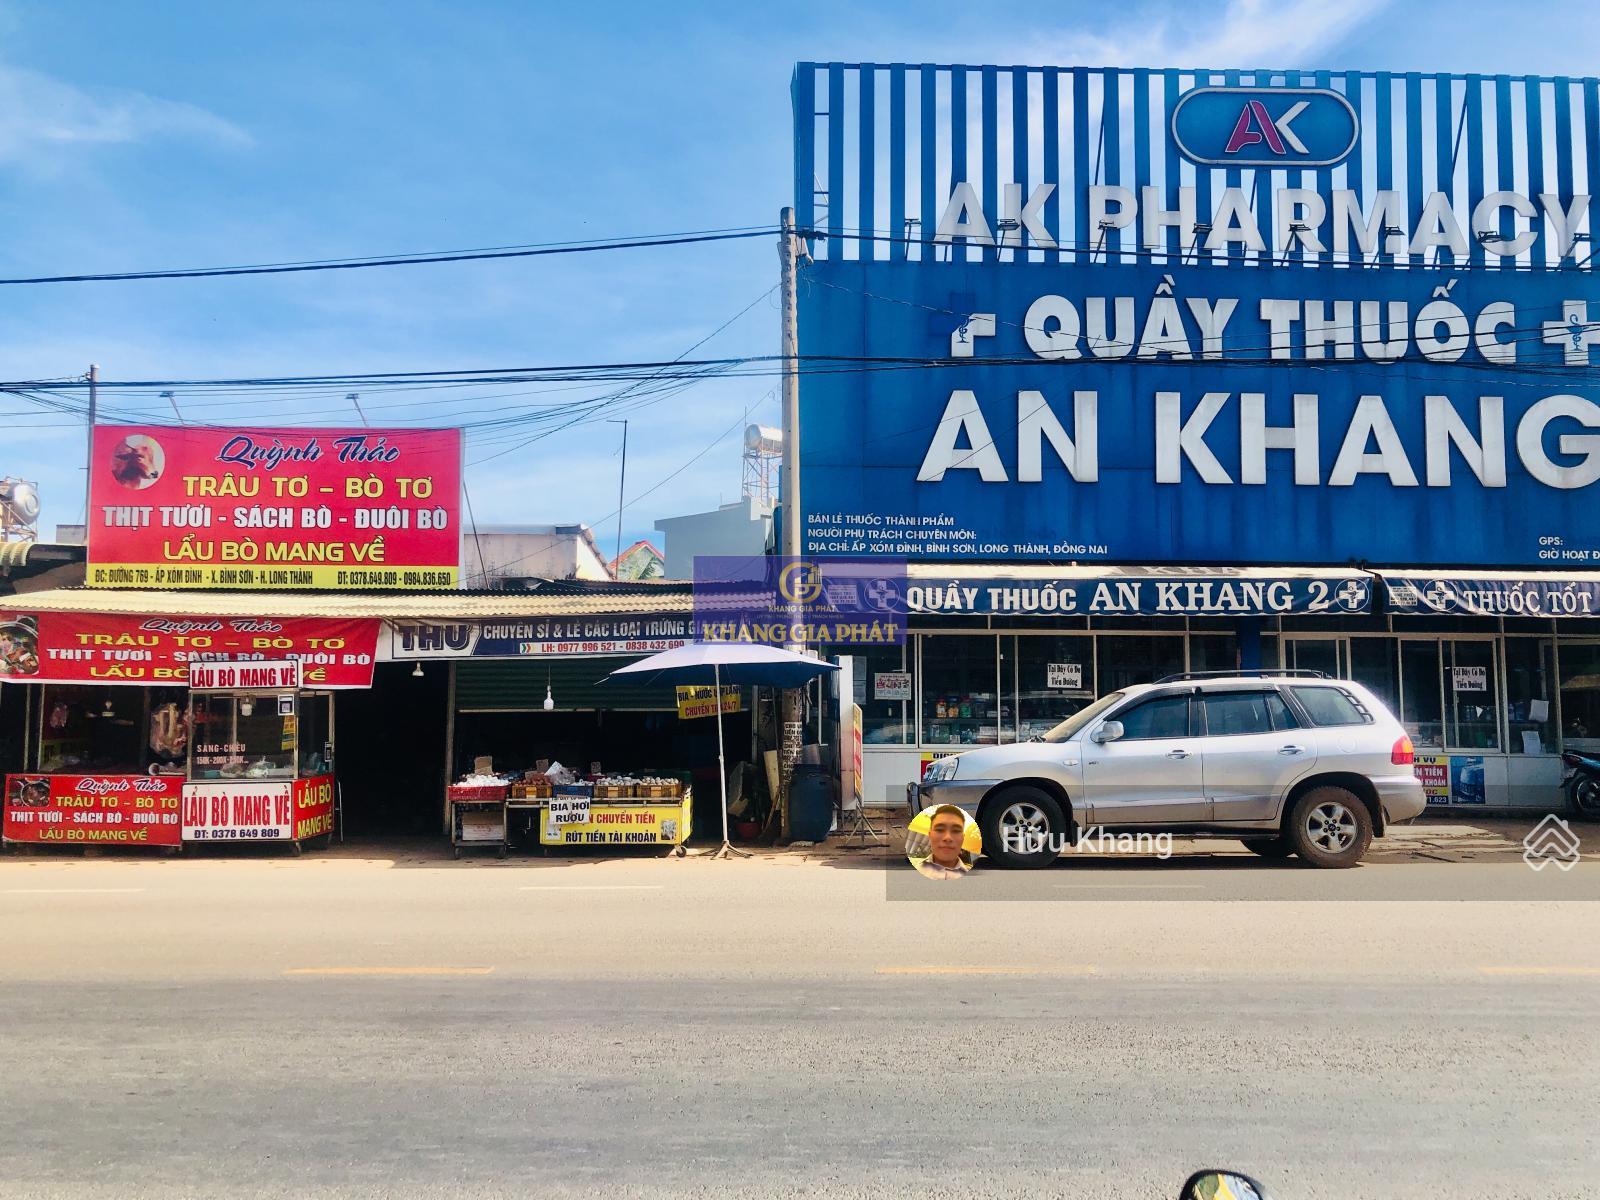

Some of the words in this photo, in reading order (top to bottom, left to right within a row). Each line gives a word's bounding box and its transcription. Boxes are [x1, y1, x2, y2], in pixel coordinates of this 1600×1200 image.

[1225, 99, 1311, 155] AK
[932, 182, 1059, 248] AK
[1088, 185, 1592, 257] PHARMACY
[1024, 274, 1239, 361] QUẦY
[1260, 279, 1516, 364] THUỐC
[915, 389, 1098, 483] AN
[1155, 391, 1600, 489] KHANG
[332, 435, 401, 463] Thảo
[183, 472, 260, 497] TRÂU
[272, 475, 311, 498] TƠ
[345, 473, 385, 498] BÒ
[395, 476, 433, 499] TƠ
[102, 506, 153, 531] THỊT
[160, 504, 211, 528] TƯƠI
[233, 503, 294, 530] SÁCH
[302, 504, 332, 530] BÒ
[354, 505, 409, 530] ĐUÔI
[417, 505, 448, 530] BÒ
[845, 513, 882, 525] THUỐC
[885, 515, 921, 525] THÀNH
[922, 513, 954, 526] PHẨM
[808, 527, 841, 538] NGƯỜI
[844, 529, 865, 540] PHỤ
[867, 528, 902, 539] TRÁCH
[905, 528, 947, 540] CHUYÊN
[949, 528, 977, 540] MÔN:
[1538, 536, 1564, 546] GPS:
[164, 534, 213, 561] LẨU
[222, 536, 260, 561] BÒ
[266, 542, 344, 562] MANG
[349, 535, 385, 562] VỀ
[808, 541, 826, 553] ĐỊA
[851, 541, 867, 552] ẤP
[869, 541, 893, 553] XÓM
[896, 543, 924, 555] ĐÌNH,
[926, 543, 950, 553] BÌNH
[952, 543, 977, 555] SƠN,
[979, 544, 1009, 553] LONG
[1013, 543, 1051, 555] THÀNH,
[1053, 541, 1086, 554] ĐỒNG
[1088, 545, 1108, 554] NAI
[1538, 547, 1560, 559] GIỜ
[1562, 550, 1590, 562] HOẠT
[269, 570, 287, 584] LONG
[906, 579, 978, 611] QUẦY
[987, 581, 1077, 610] THUỐC
[1089, 582, 1142, 611] AN
[1156, 581, 1295, 612] KHANG
[1307, 582, 1330, 611] 2
[1462, 581, 1541, 613] THUỐC
[1546, 581, 1593, 613] TỐT
[484, 621, 533, 639] CHUYÊN
[553, 623, 563, 638] &
[584, 619, 610, 637] CÁC
[613, 620, 641, 640] LOẠI
[645, 617, 685, 636] TRỨNG
[75, 632, 159, 646] TRÂU
[173, 635, 213, 648] TƠ
[253, 635, 294, 649] BÒ
[307, 636, 345, 649] TƠ
[541, 643, 555, 653] LH:
[558, 643, 579, 652] 0977
[582, 642, 598, 652] 996
[601, 642, 616, 651] 521
[626, 641, 648, 650] 0838
[650, 641, 666, 650] 432
[47, 648, 95, 662] THỊT
[102, 648, 152, 662] TƯƠI
[342, 653, 371, 665] BÒ
[219, 666, 236, 687] BÒ
[240, 668, 277, 687] MANG
[280, 661, 296, 686] VỀ
[56, 794, 94, 807] TRÂU
[298, 780, 317, 808] LẨU
[319, 779, 331, 804] BÒ
[183, 786, 207, 827] LẨU
[211, 791, 229, 826] BÒ
[233, 795, 271, 826] MANG
[275, 785, 290, 825] VỀ
[551, 803, 568, 811] BIA
[11, 811, 35, 824] THỊT
[38, 810, 63, 823] TƯƠI
[74, 811, 103, 823] SÁCH
[556, 812, 585, 823] RƯỢU
[596, 810, 633, 823] CHUYỂN
[67, 827, 86, 840] BÒ
[88, 830, 127, 840] MANG
[194, 829, 208, 839] ĐT:
[212, 829, 237, 838] 0378
[239, 829, 258, 838] 649
[261, 829, 280, 838] 809
[297, 817, 321, 839] MANG
[566, 831, 583, 842] RÚT
[608, 830, 624, 842] TÀI
[625, 829, 656, 842] KHOẢN
